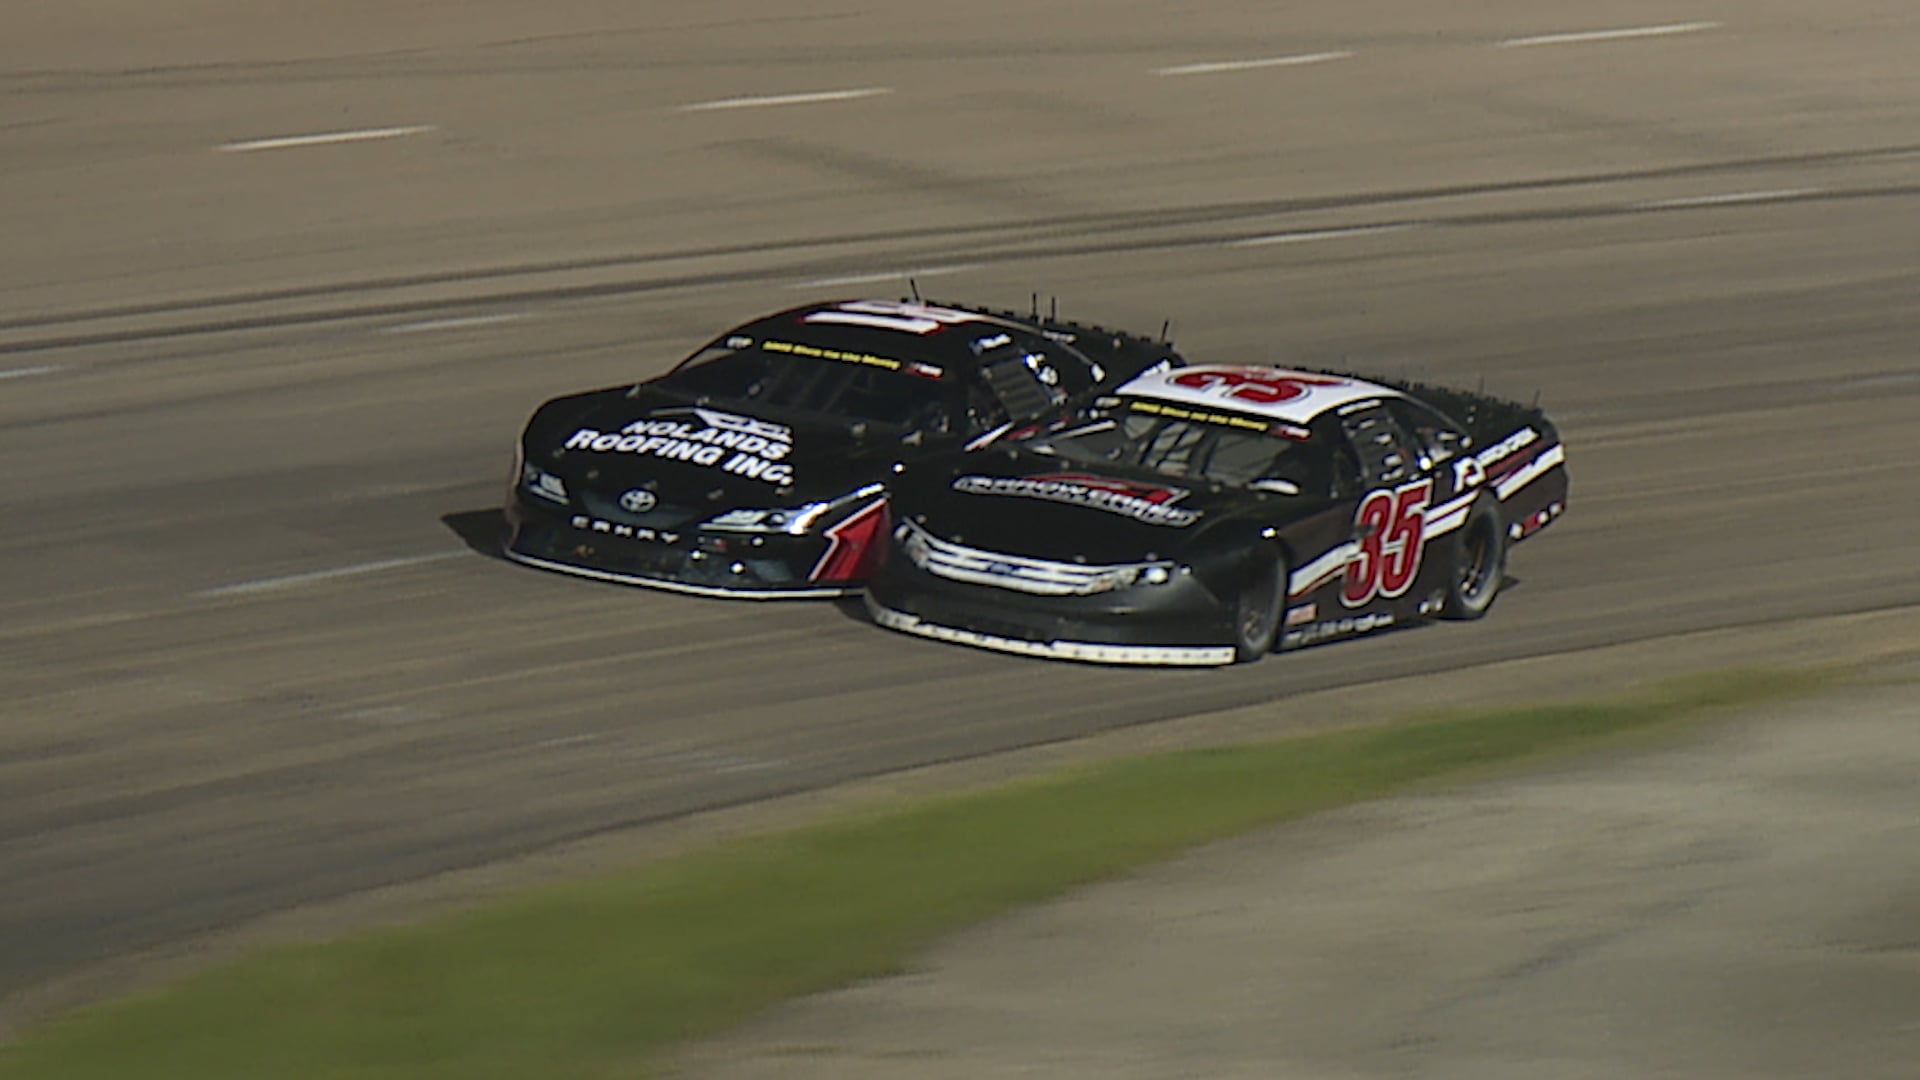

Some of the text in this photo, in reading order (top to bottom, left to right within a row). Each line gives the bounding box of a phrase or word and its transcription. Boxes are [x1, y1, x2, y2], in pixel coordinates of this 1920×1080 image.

[565, 428, 795, 486] ROOFING INC.
[620, 419, 792, 461] NOLANDS
[1339, 477, 1434, 610] 35
